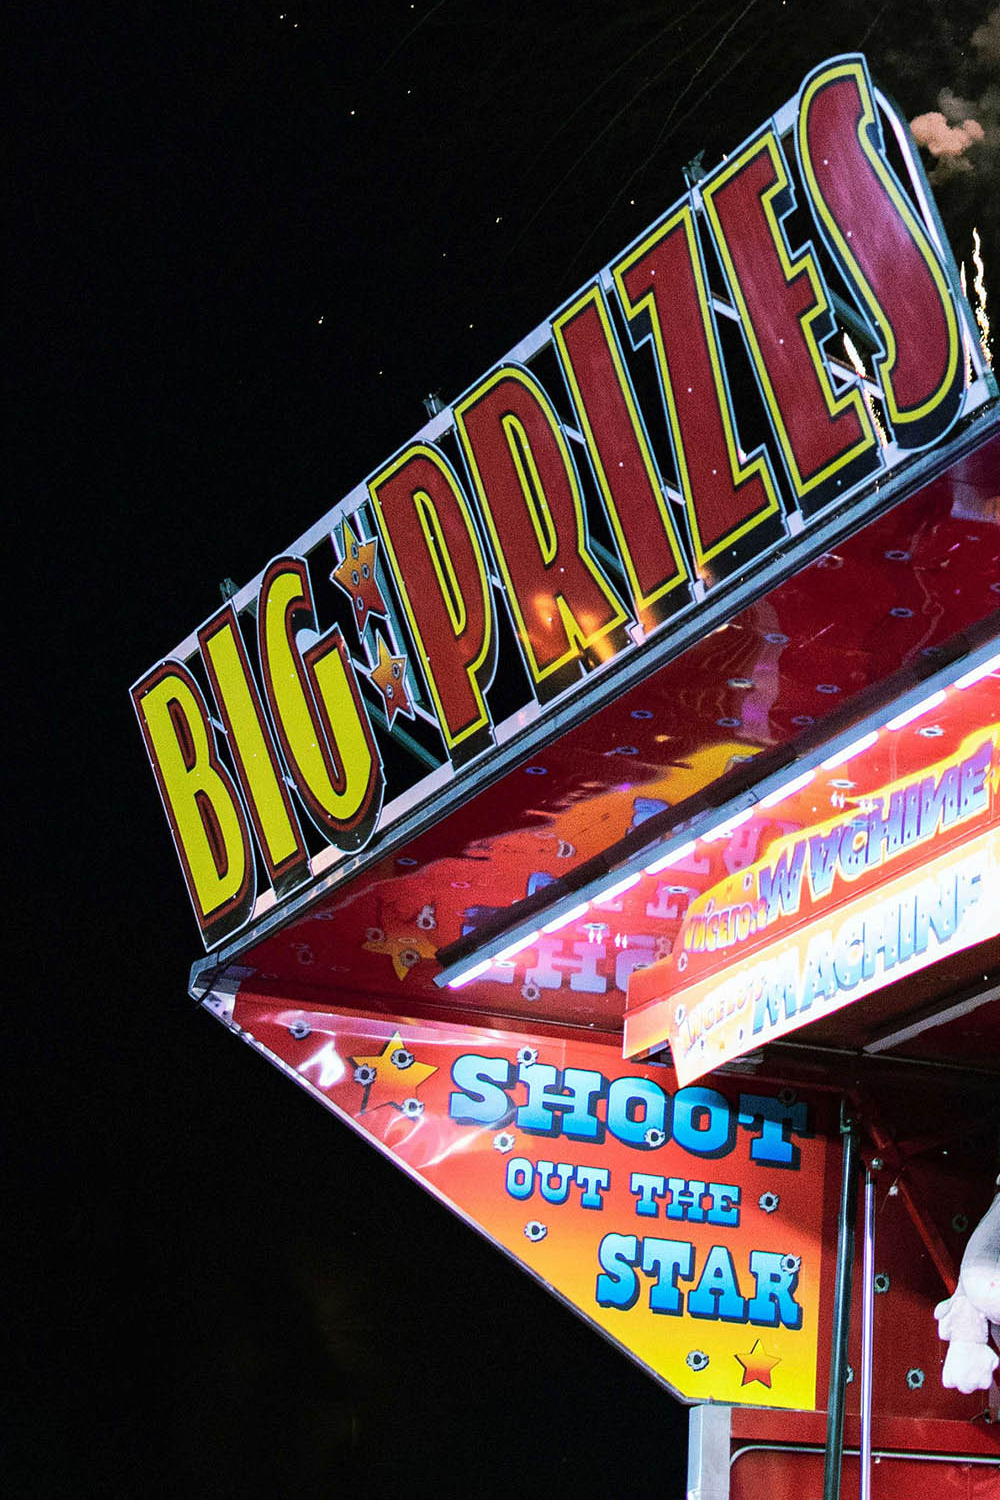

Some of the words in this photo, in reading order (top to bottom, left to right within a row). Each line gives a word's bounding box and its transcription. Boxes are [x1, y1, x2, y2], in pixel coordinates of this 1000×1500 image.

[130, 553, 384, 949] BIG
[367, 53, 967, 770] PRIZES
[449, 1053, 809, 1169] SHOOT
[504, 1156, 609, 1210] OUT
[629, 1172, 741, 1227] THE
[595, 1232, 804, 1331] STAR
